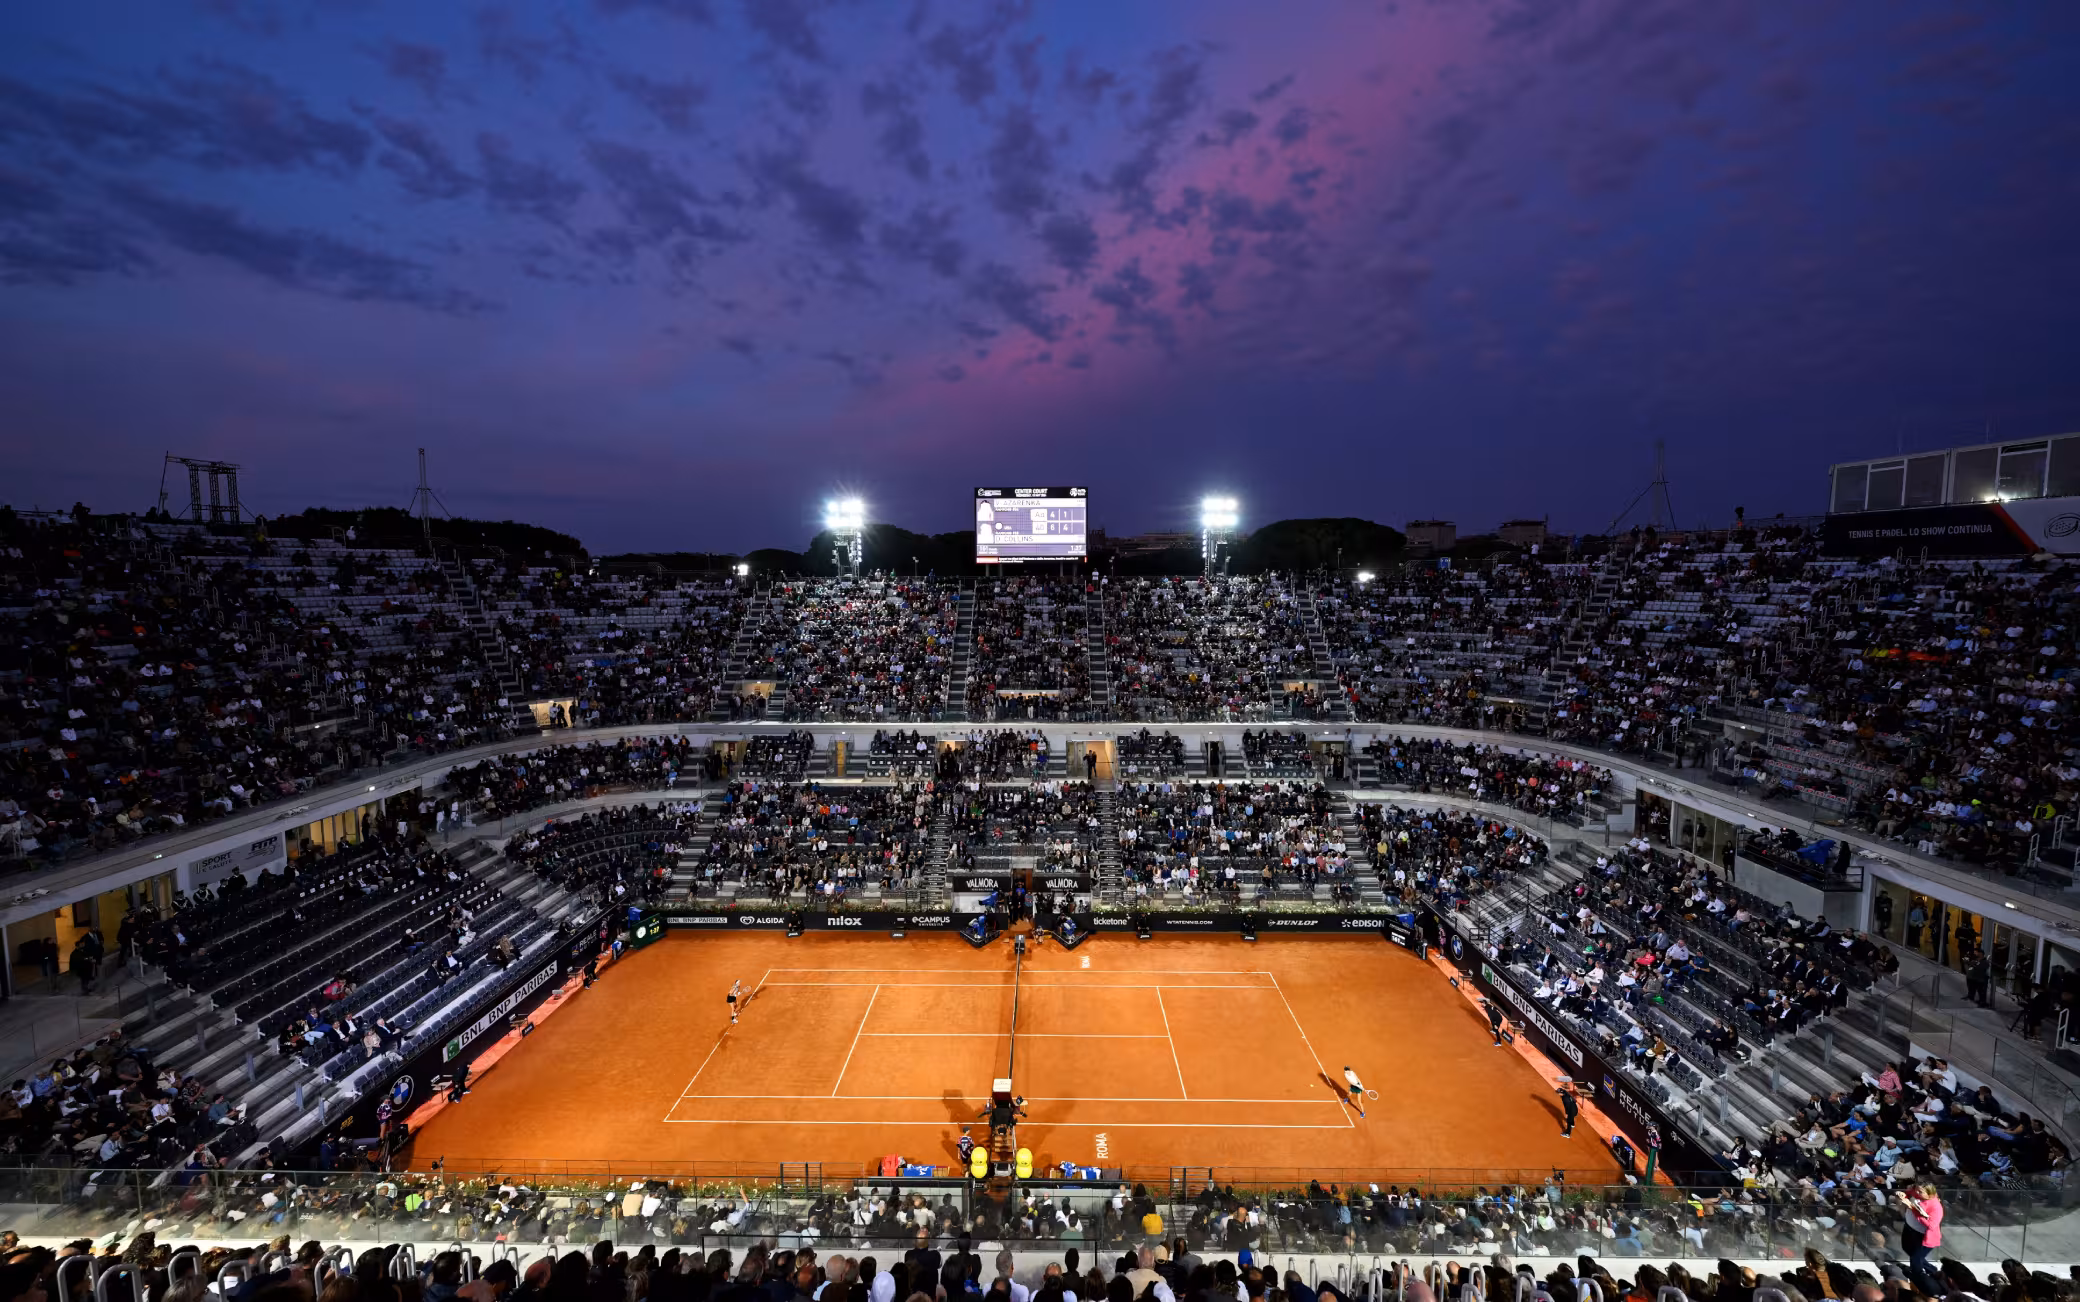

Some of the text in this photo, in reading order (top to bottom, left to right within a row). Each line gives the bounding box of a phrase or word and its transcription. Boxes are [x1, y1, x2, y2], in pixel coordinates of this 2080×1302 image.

[1848, 529, 1874, 539] TENNIS
[1875, 529, 1881, 538] E
[1909, 527, 1920, 536] LO
[1921, 526, 1946, 536] SHOW
[1947, 524, 1993, 535] CONTINUA
[202, 851, 232, 867] SPORT
[208, 859, 233, 871] SALUTE
[966, 878, 999, 888] VALMORA
[1045, 878, 1079, 888] VALMORA
[827, 915, 862, 926] nilox
[1093, 917, 1128, 926] ticketone
[461, 963, 555, 1046] BNL BNP PARIBAS
[1493, 975, 1579, 1062] BNL BNP PARIBAS
[1619, 1089, 1652, 1124] REALE
[1619, 1098, 1649, 1127] MUTU
[1096, 1132, 1109, 1159] ROMA
